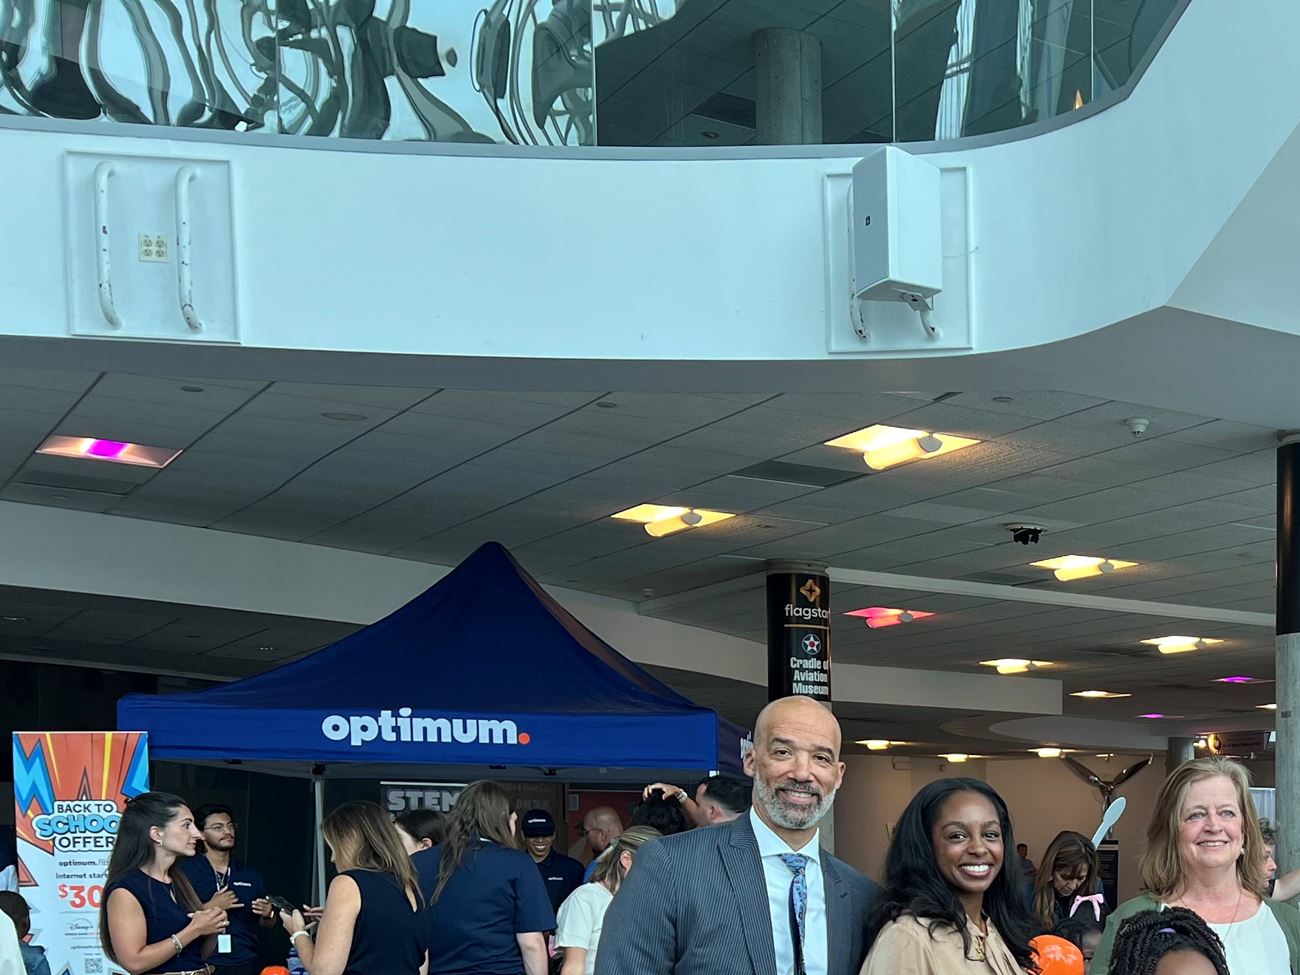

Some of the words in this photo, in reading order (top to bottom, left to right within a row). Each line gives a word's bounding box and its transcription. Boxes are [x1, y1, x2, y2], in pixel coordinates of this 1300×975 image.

[790, 657, 822, 669] Cradle
[793, 670, 828, 682] Aviation
[792, 683, 829, 695] Museum
[388, 790, 460, 812] STEM
[57, 803, 92, 814] BACK
[95, 803, 114, 814] TO
[34, 813, 120, 838] SCHOO
